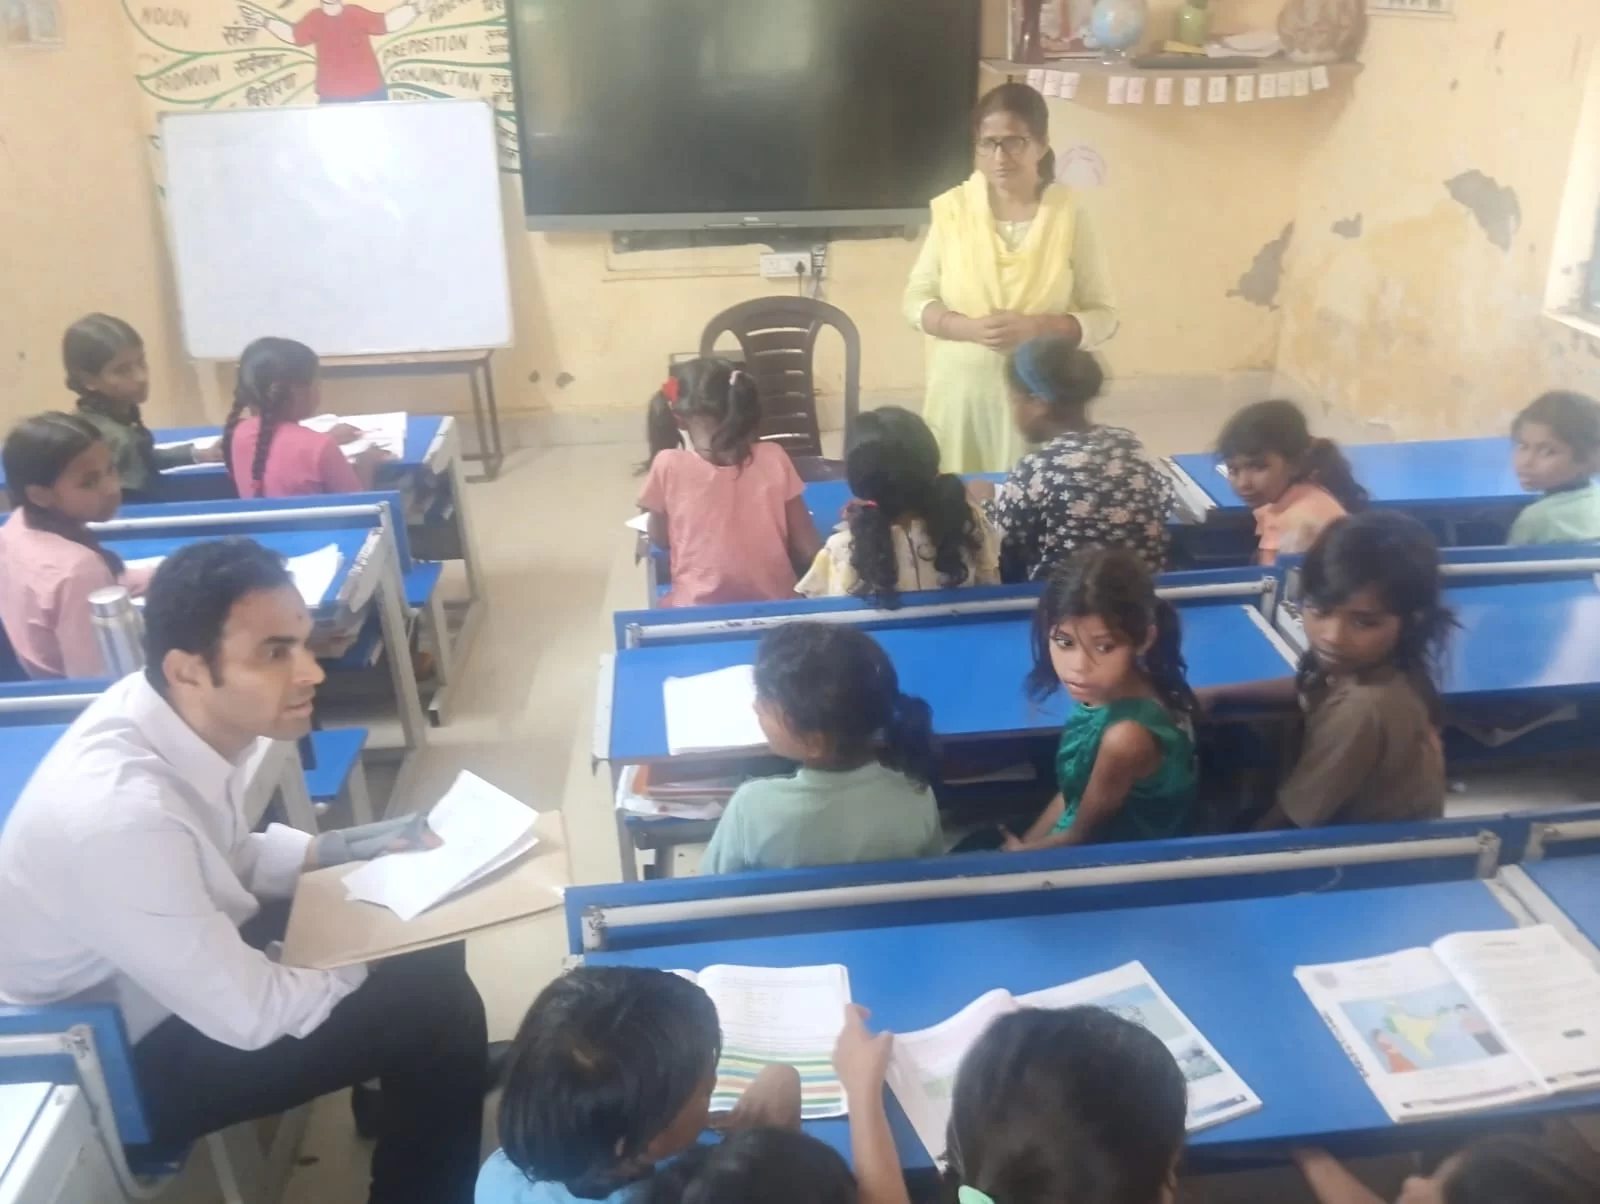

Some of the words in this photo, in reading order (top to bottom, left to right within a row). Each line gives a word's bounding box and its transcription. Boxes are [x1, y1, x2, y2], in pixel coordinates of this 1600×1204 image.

[142, 7, 189, 28] NOUN
[383, 35, 468, 63] PREPOSITION
[390, 67, 481, 91] CONJUNCTION
